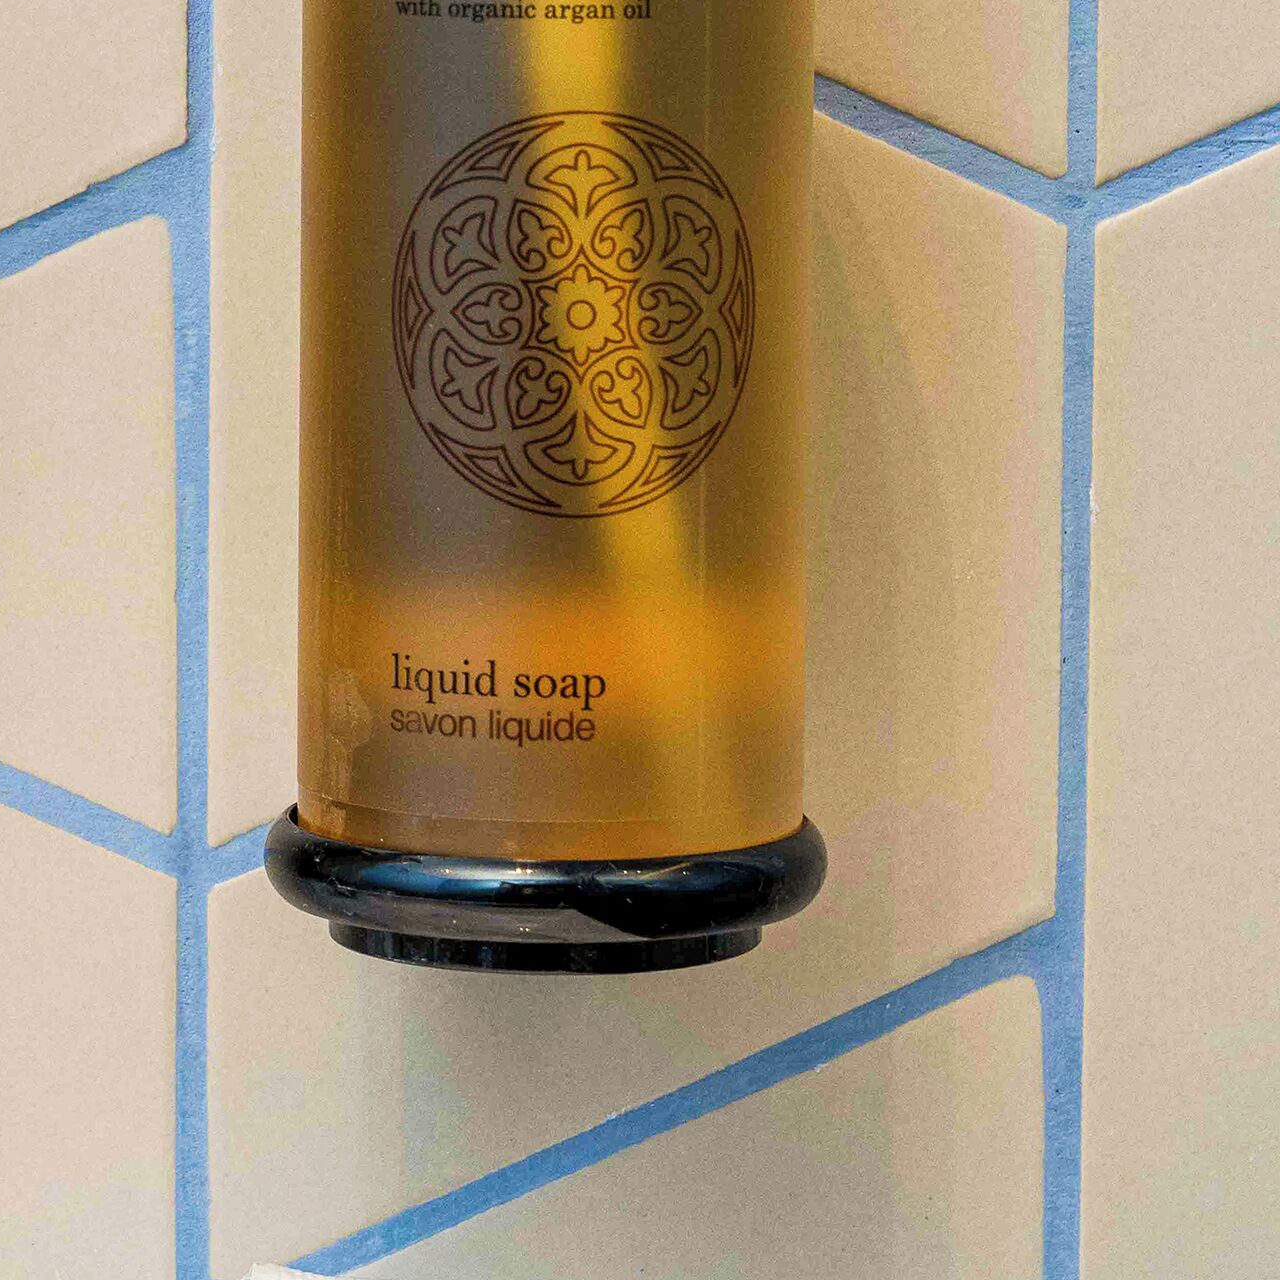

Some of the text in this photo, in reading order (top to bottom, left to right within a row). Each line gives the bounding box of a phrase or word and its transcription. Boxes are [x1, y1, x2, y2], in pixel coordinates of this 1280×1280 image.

[544, 3, 616, 24] argan
[391, 652, 607, 711] liquid soap
[389, 706, 596, 748] savon liquide
